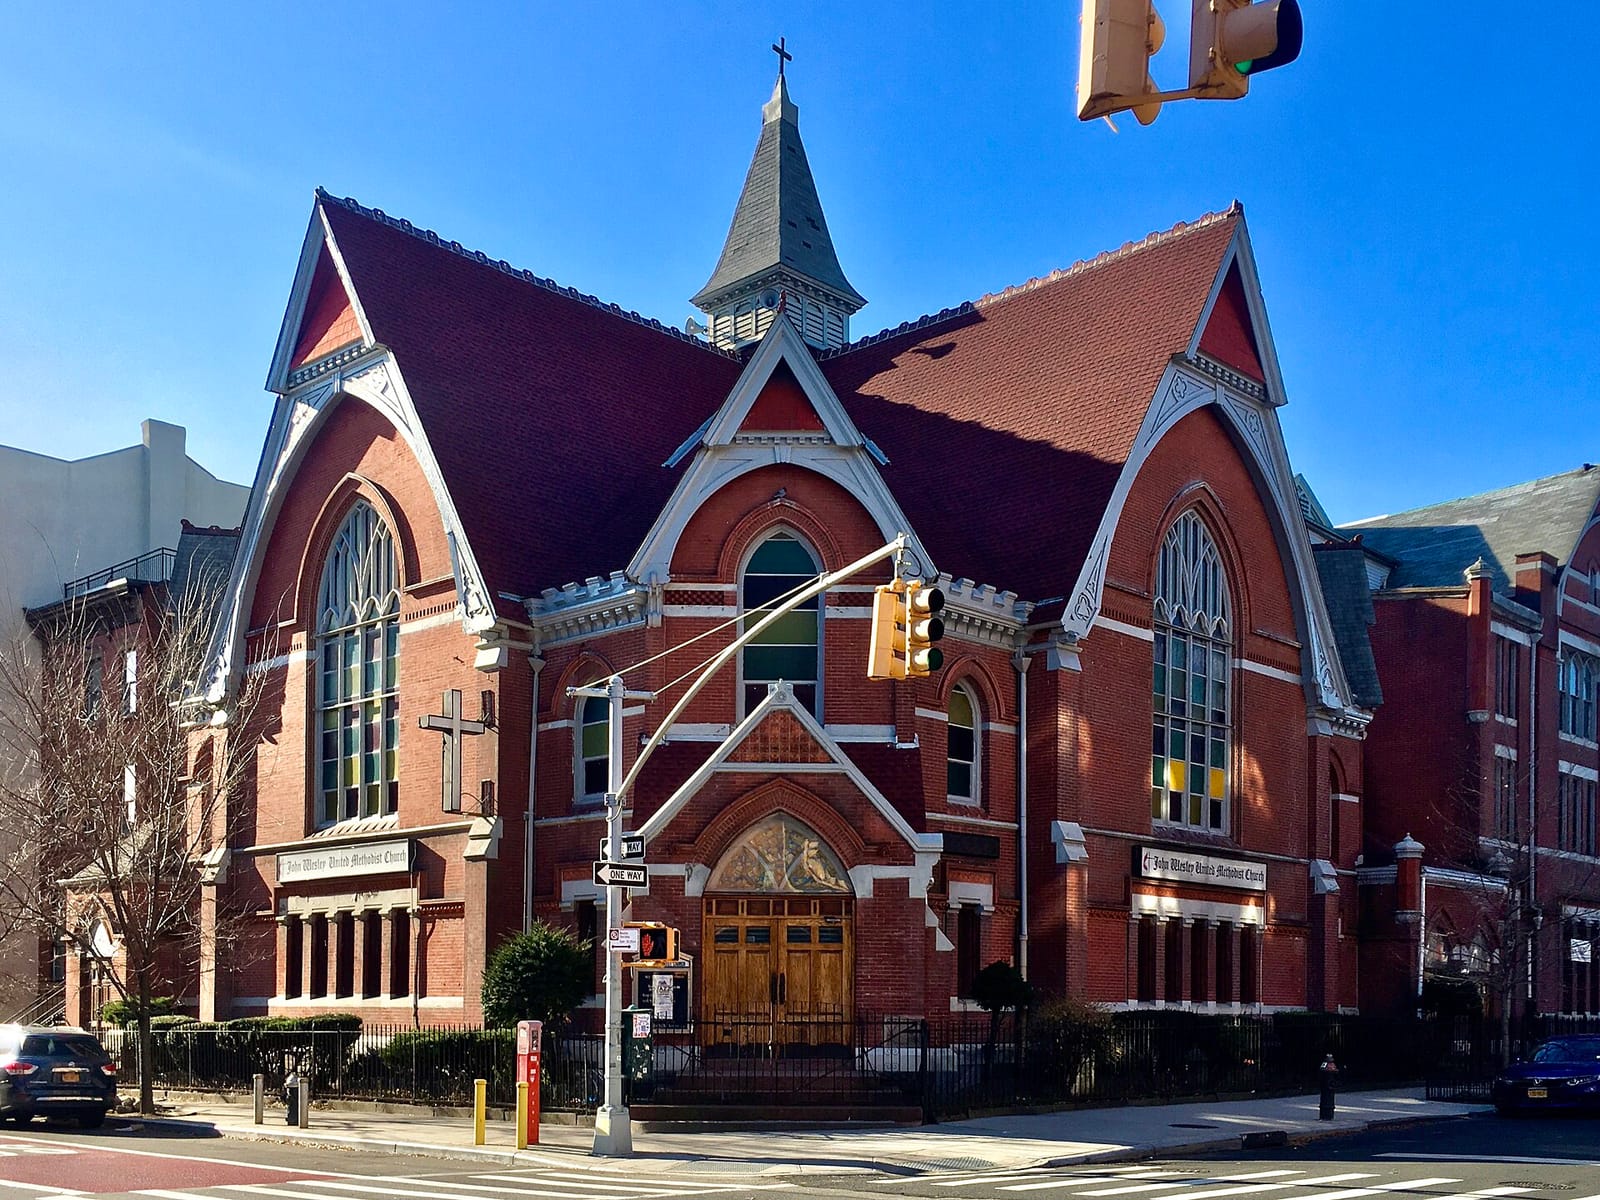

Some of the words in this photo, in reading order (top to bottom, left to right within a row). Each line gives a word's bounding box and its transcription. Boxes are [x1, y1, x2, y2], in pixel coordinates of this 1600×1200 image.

[627, 842, 640, 852] WAY
[286, 860, 301, 875] John
[302, 858, 325, 872] Wesley
[328, 855, 349, 869] United
[350, 853, 383, 868] Methodist
[384, 849, 406, 864] Church
[1153, 856, 1169, 871] John
[1171, 858, 1194, 876] Wesley
[1195, 861, 1215, 876] United
[1216, 865, 1244, 880] Methodist
[1245, 868, 1264, 883] Church
[610, 870, 625, 880] ONE
[627, 871, 642, 881] WAY
